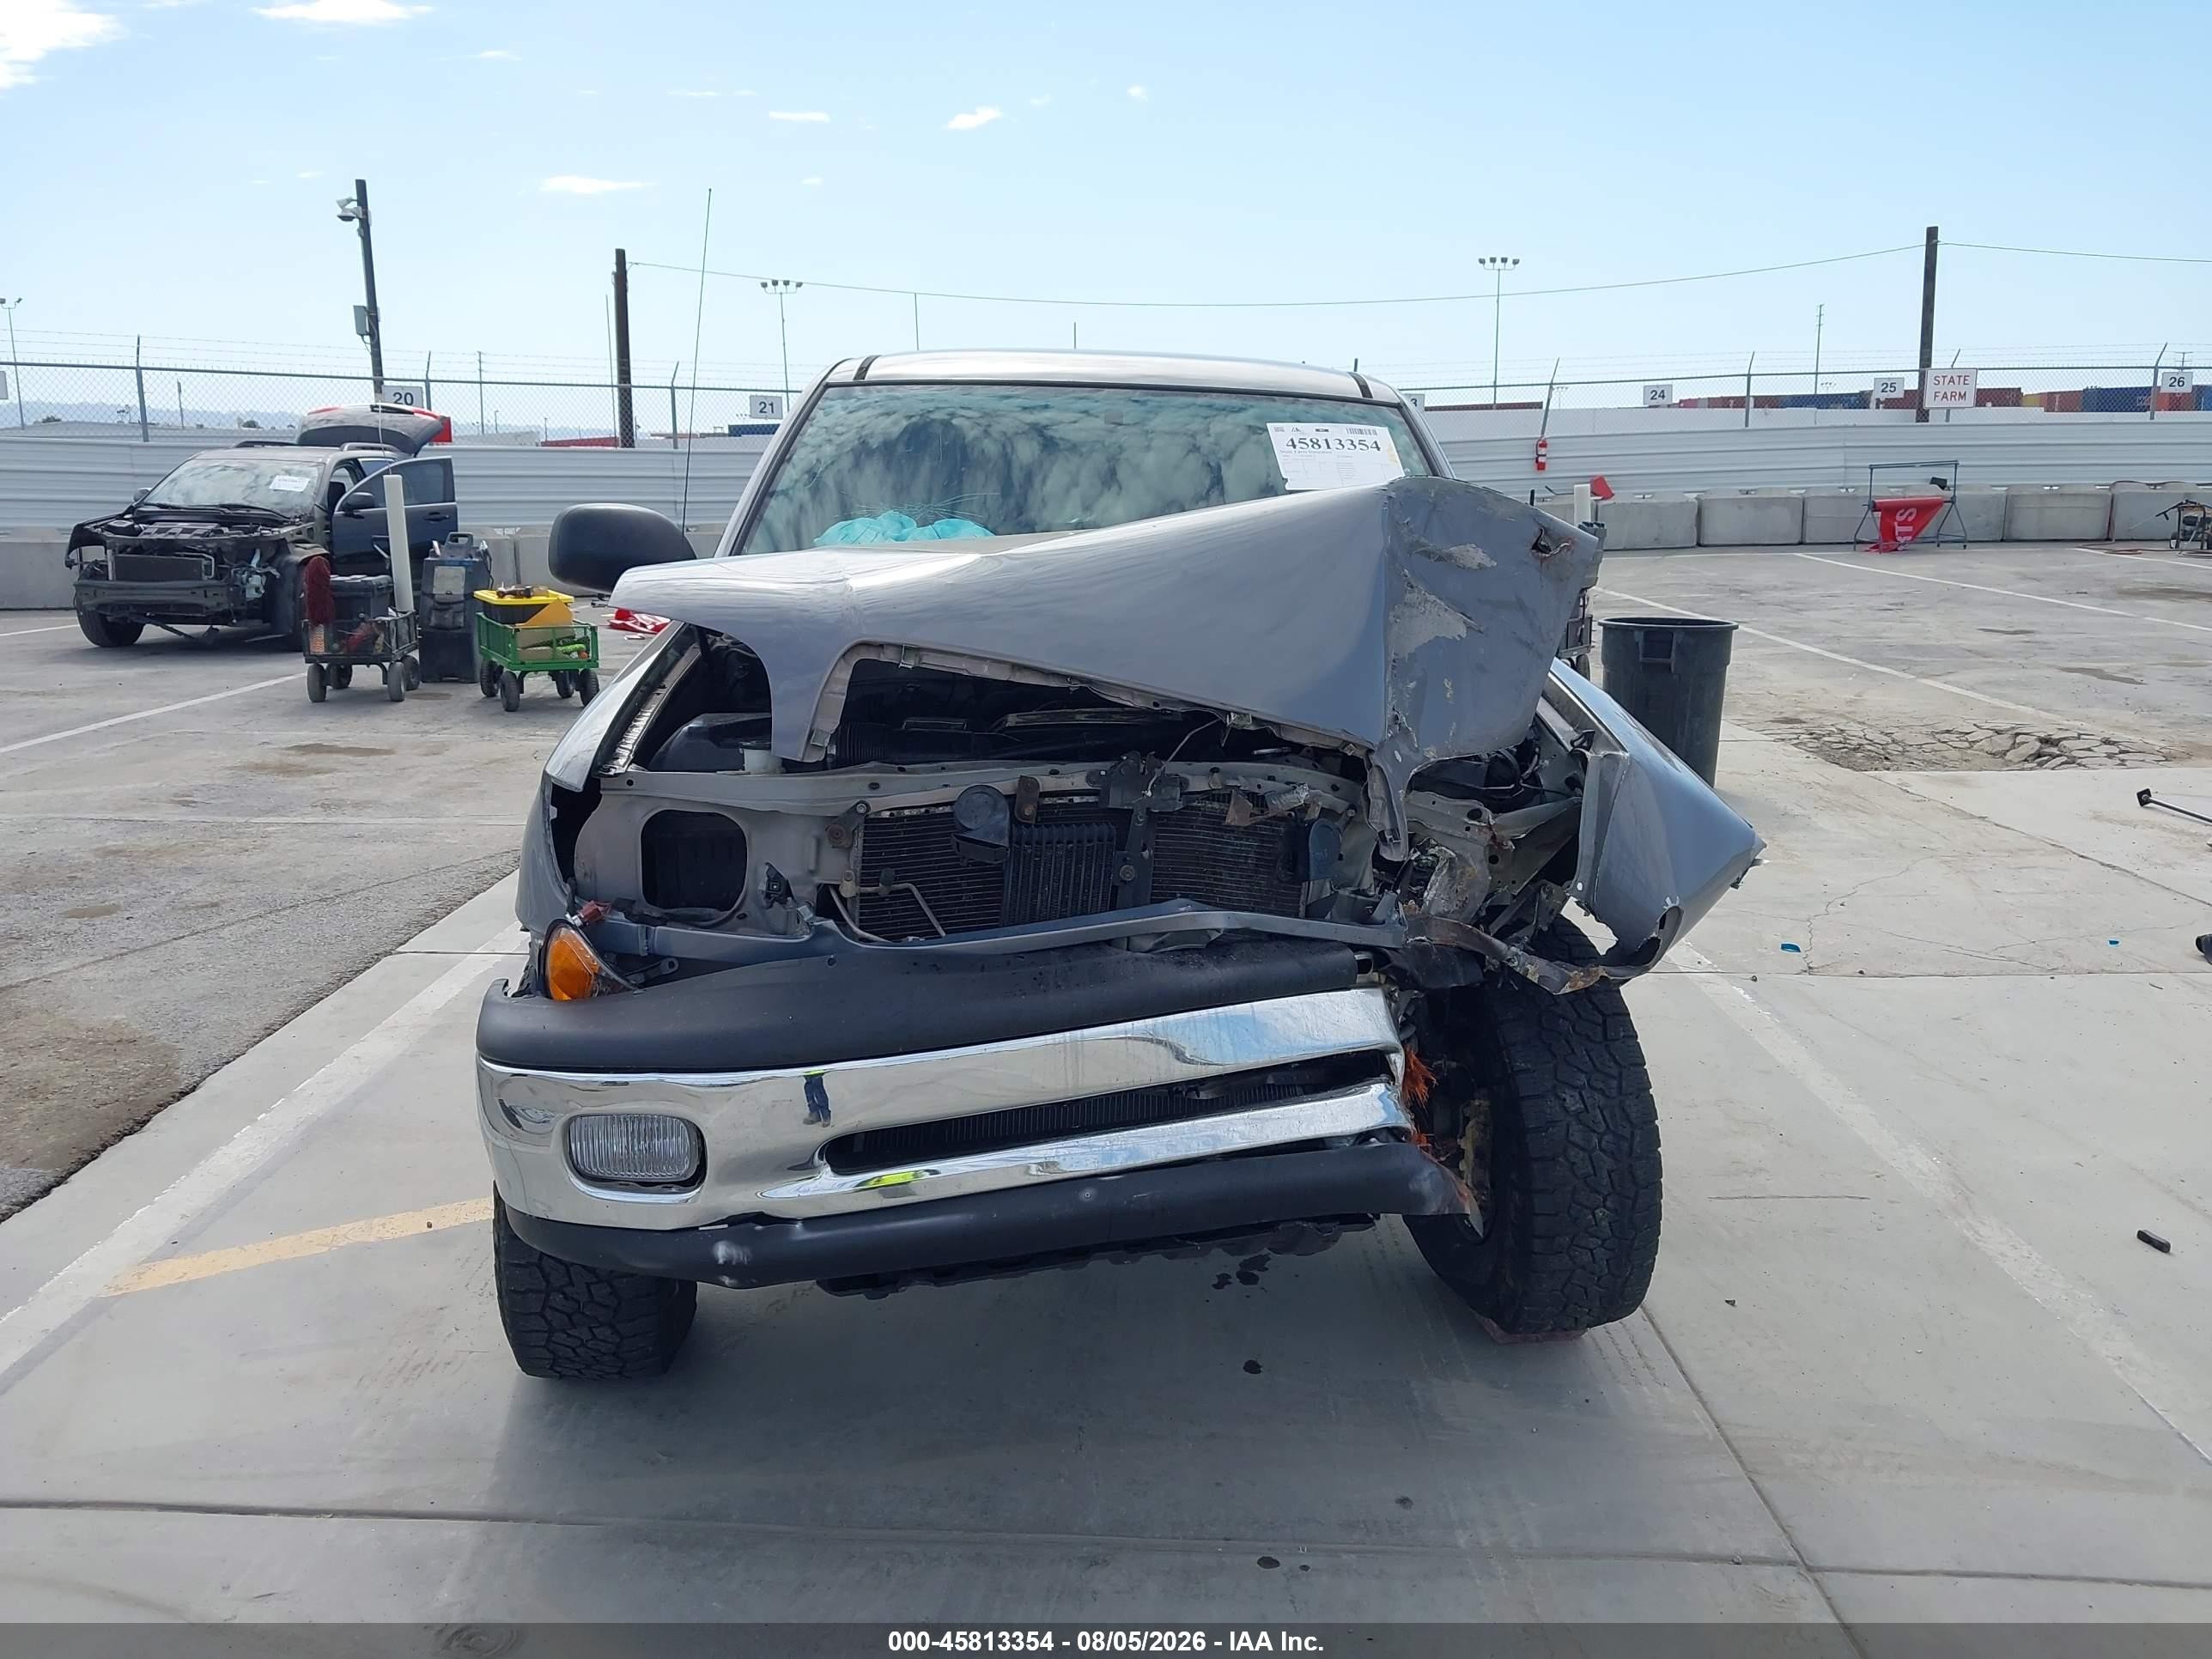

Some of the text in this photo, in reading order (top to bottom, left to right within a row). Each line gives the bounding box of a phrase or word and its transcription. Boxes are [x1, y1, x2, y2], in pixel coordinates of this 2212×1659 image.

[1933, 375, 1970, 386] STATE
[2169, 377, 2185, 387] 26
[1881, 382, 1897, 393] 25
[392, 392, 414, 406] 20
[1650, 389, 1666, 400] 24
[1933, 391, 1966, 402] FARM
[758, 401, 775, 414] 21
[1285, 437, 1382, 452] 45813354
